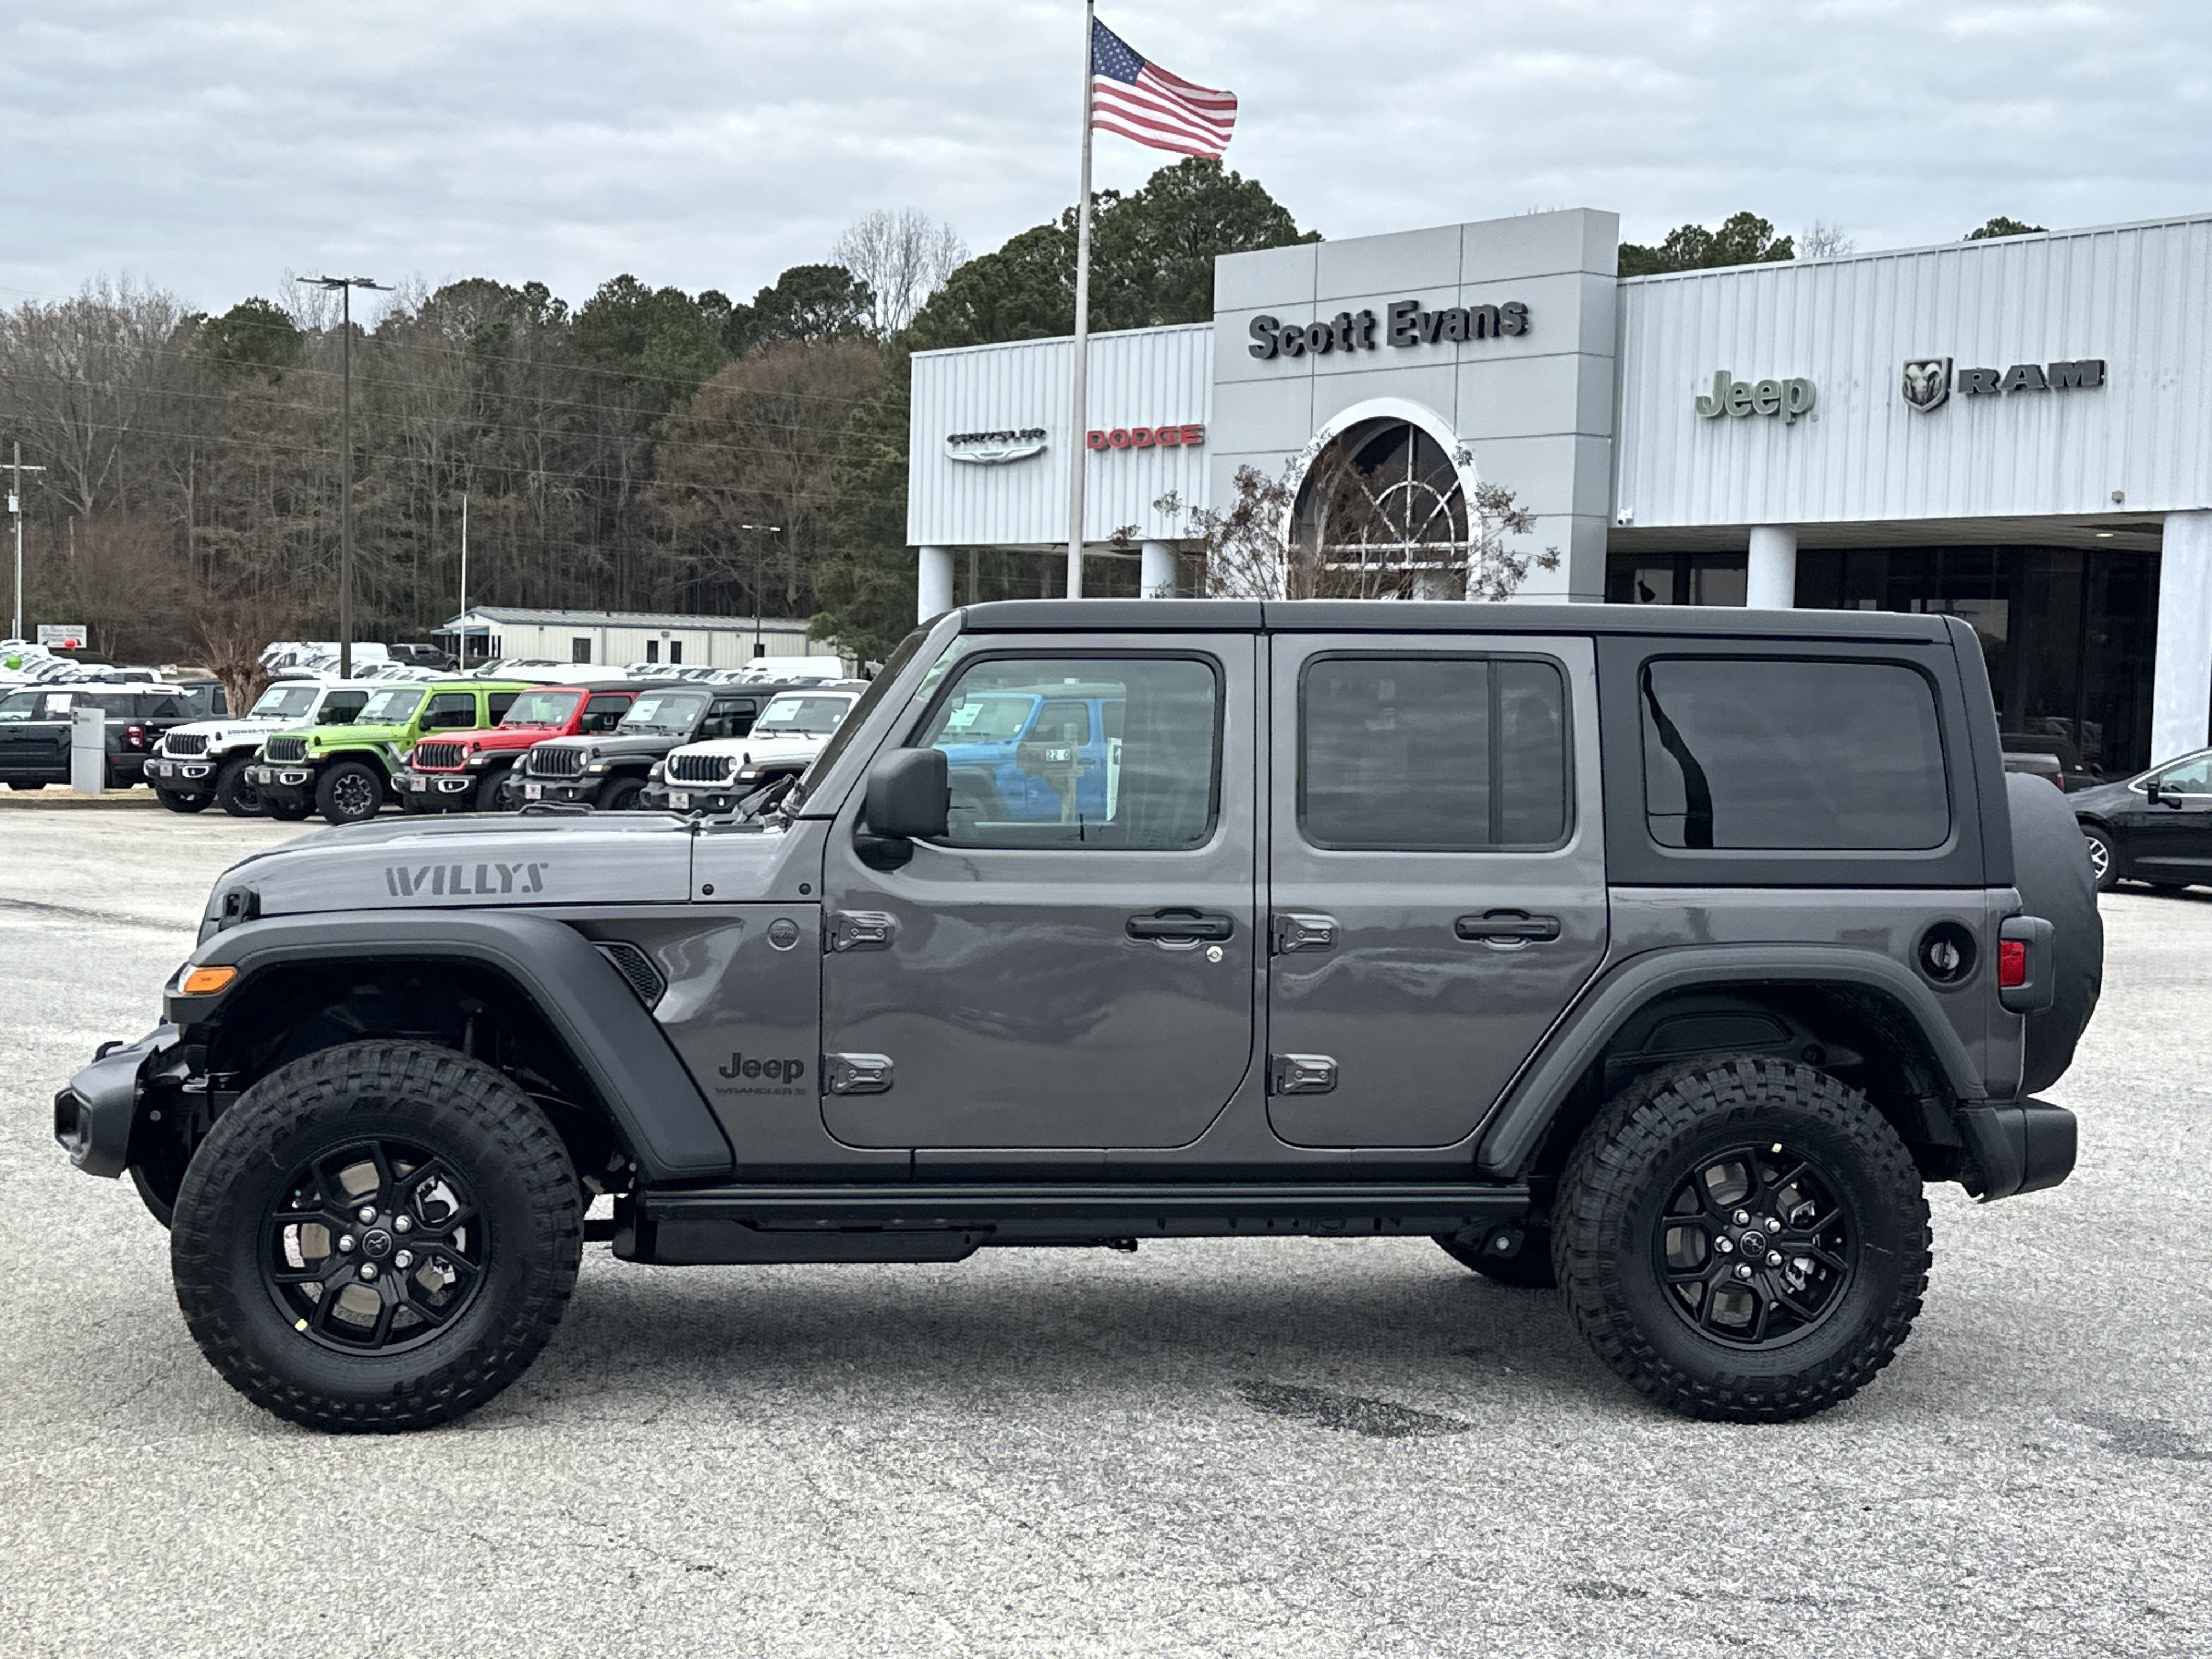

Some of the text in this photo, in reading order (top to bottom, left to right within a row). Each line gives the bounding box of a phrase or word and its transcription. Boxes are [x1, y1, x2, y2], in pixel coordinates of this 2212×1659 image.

[1249, 300, 1530, 359] Scott Evans
[1958, 359, 2105, 394] RAM
[1696, 370, 1816, 425] Jeep
[1087, 424, 1205, 450] DODGE
[386, 863, 549, 896] WILLYS
[719, 1052, 805, 1084] Jeep
